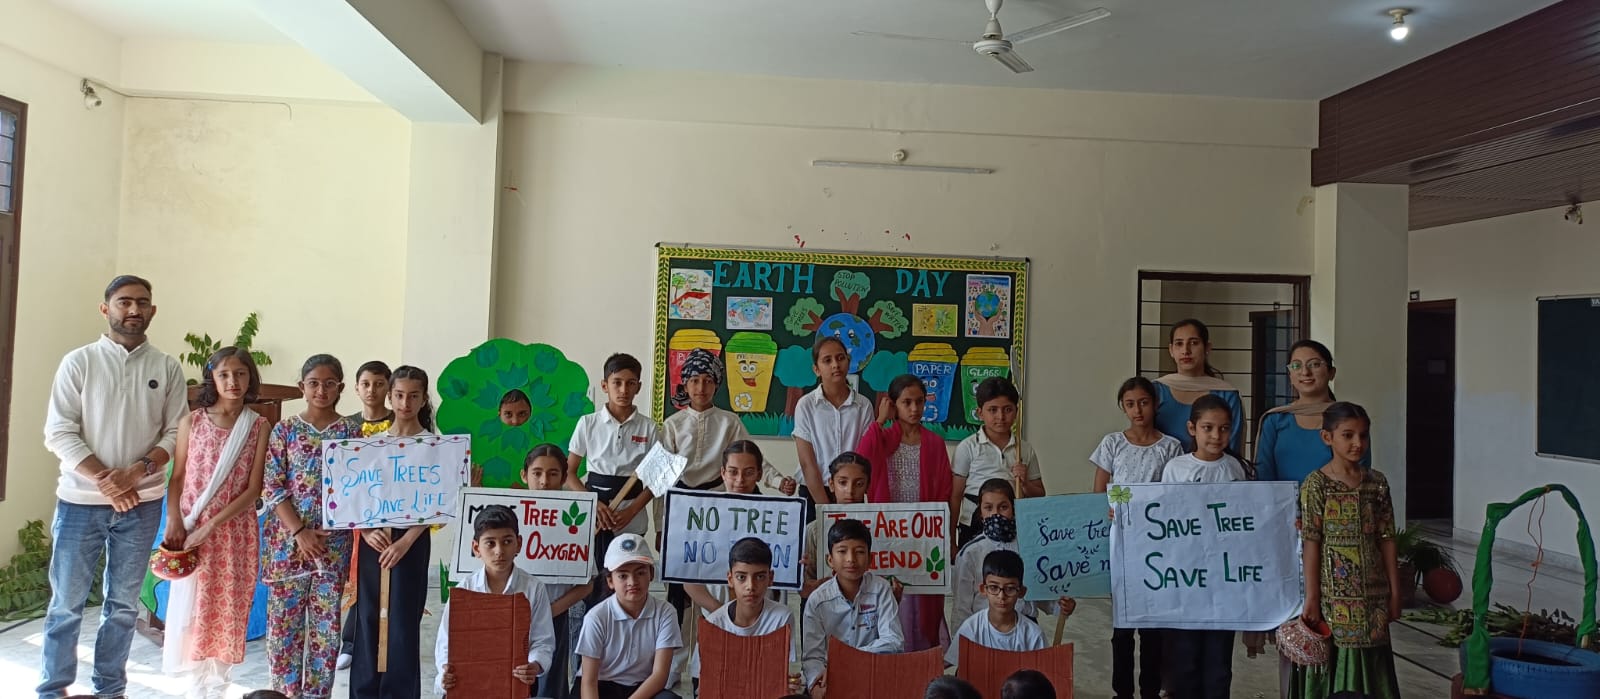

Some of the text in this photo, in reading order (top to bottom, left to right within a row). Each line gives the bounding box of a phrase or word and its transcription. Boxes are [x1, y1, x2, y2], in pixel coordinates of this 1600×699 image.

[712, 260, 952, 298] EARTH DAY
[838, 271, 856, 280] STOP
[916, 363, 952, 375] PAPER
[341, 455, 441, 496] SAVE TREES
[364, 483, 406, 526] SAVE
[520, 500, 558, 527] TREE
[687, 506, 789, 536] NO TREE
[874, 511, 909, 538] ARE
[911, 512, 945, 539] OUR
[1145, 502, 1255, 541] SAVE TREE
[526, 531, 588, 561] OXYGEN
[684, 541, 717, 564] NO
[866, 550, 923, 572] IEND
[1143, 551, 1263, 591] SAVE LIFE
